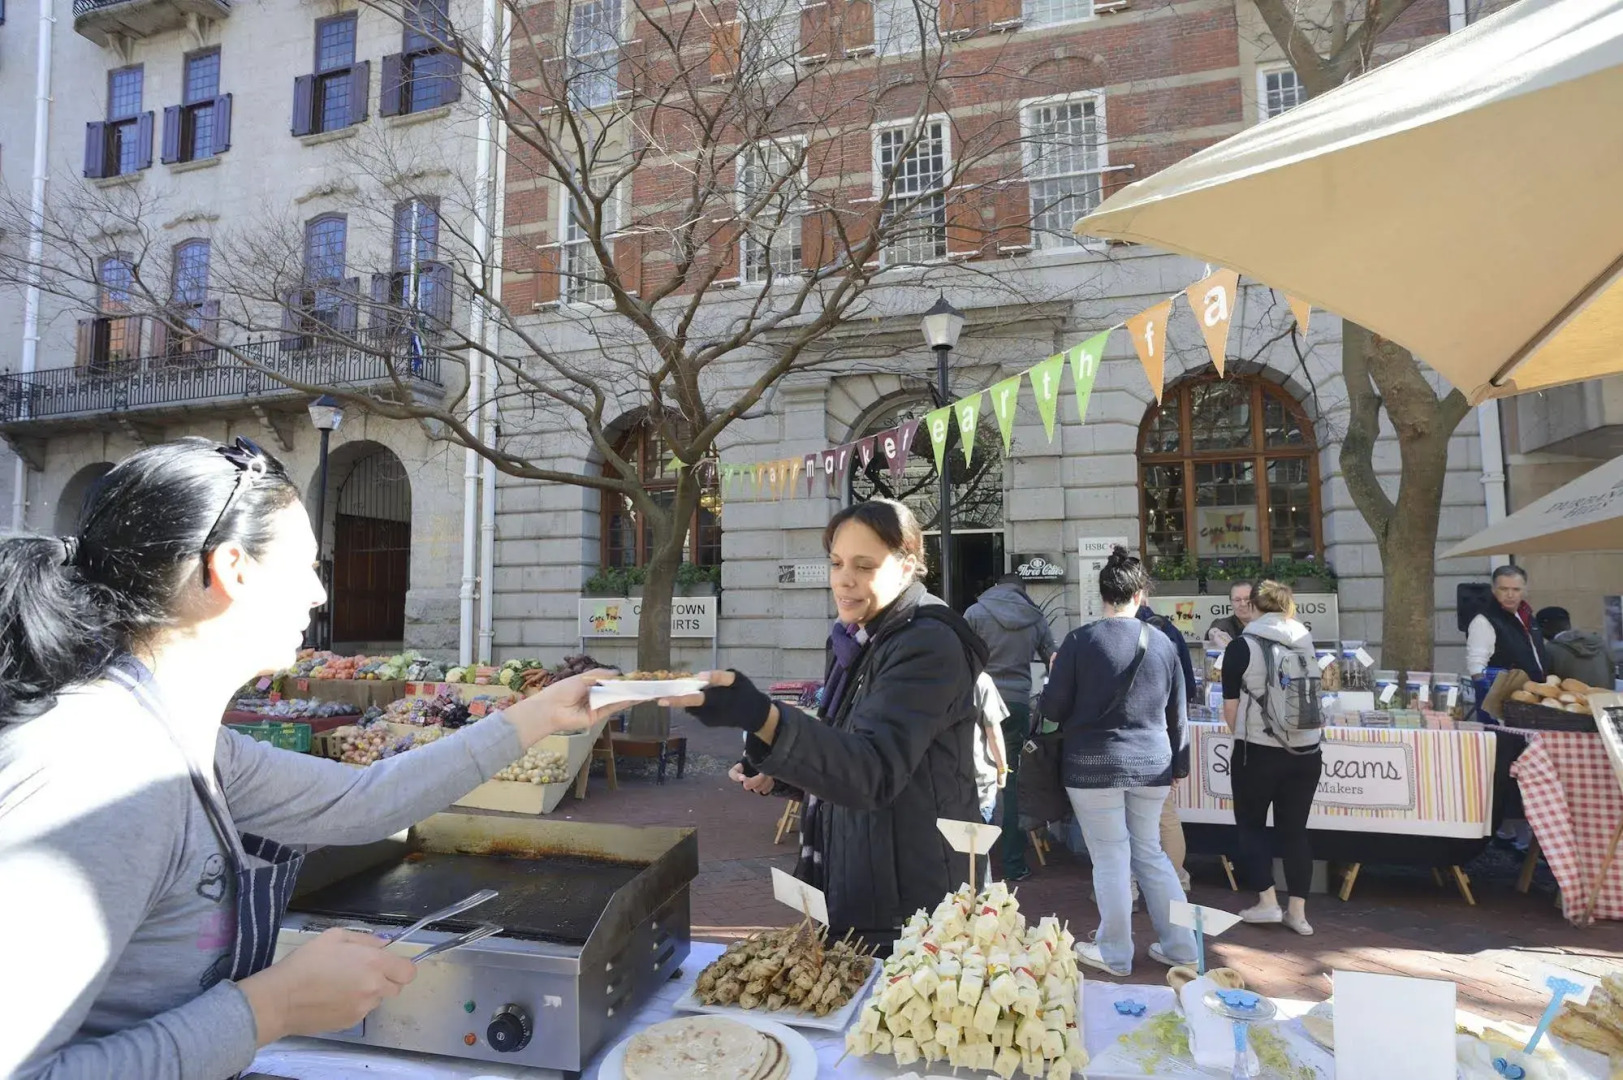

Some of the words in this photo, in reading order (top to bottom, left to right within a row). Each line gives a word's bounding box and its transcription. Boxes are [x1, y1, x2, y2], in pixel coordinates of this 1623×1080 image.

[806, 428, 910, 477] market
[933, 349, 1093, 443] earth
[1145, 285, 1229, 357] fa
[1017, 563, 1041, 576] Three
[1210, 604, 1233, 615] GIF
[1296, 603, 1327, 614] RIOS
[673, 619, 700, 630] IRTS
[1322, 760, 1402, 780] reams
[1318, 782, 1364, 794] Makers
